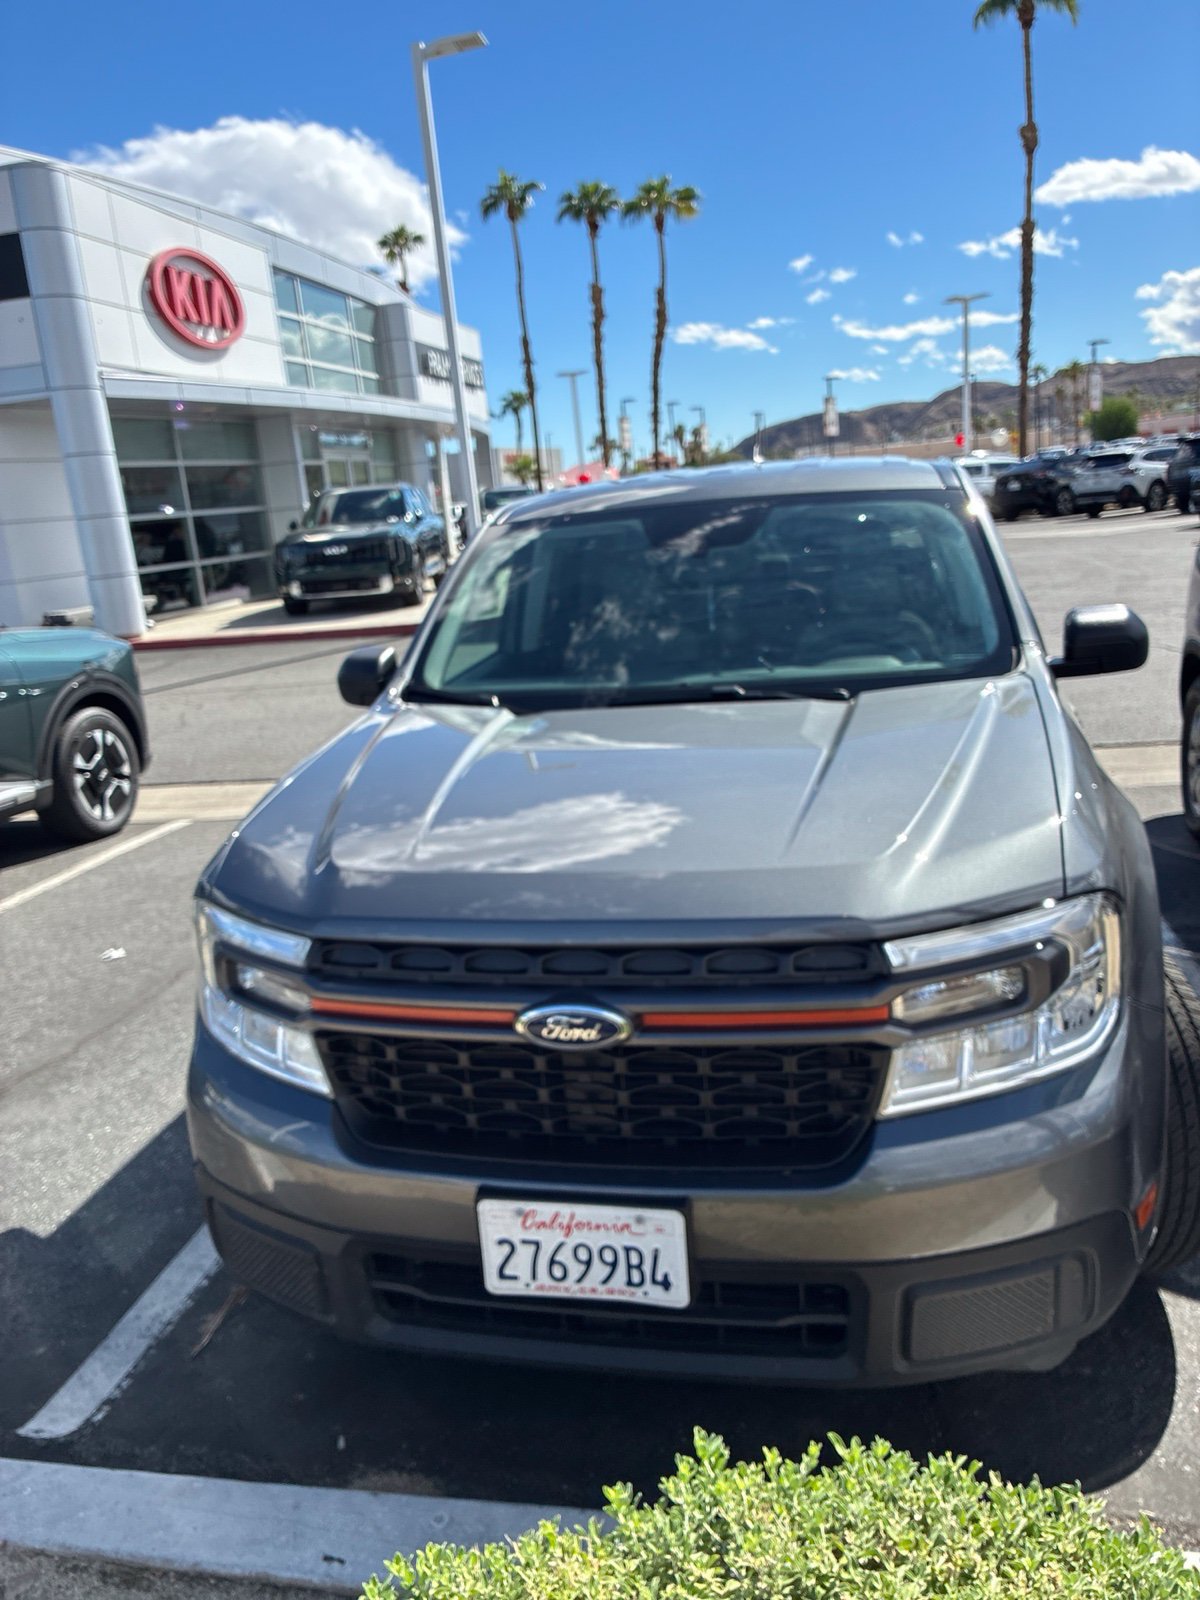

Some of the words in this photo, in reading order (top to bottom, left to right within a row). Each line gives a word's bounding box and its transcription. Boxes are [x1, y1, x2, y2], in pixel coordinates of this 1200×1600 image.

[164, 265, 236, 330] KIA
[541, 1015, 602, 1042] Ford
[520, 1208, 647, 1238] California
[496, 1236, 672, 1293] 27699B4
